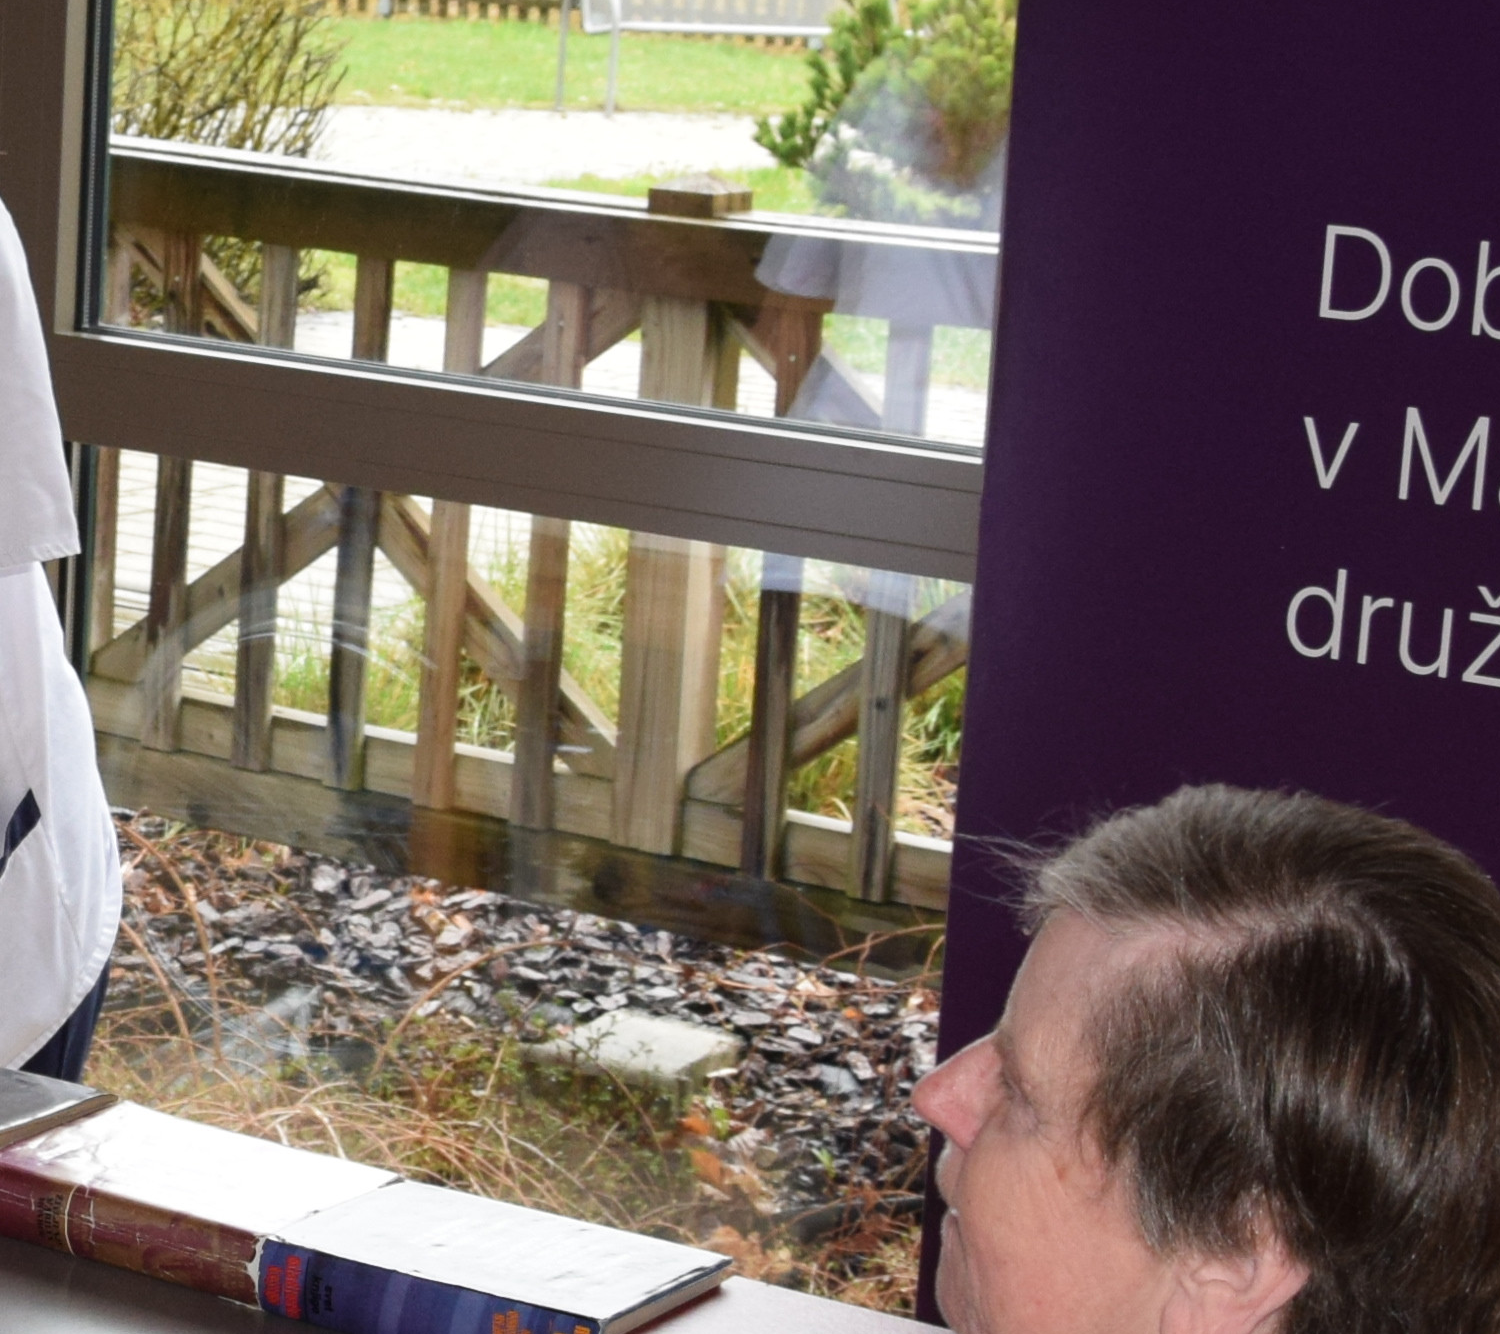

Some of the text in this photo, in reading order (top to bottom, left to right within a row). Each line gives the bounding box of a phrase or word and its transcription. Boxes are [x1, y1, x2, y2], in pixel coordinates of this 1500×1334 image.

[1301, 414, 1359, 492] v
[309, 1275, 323, 1314] knjige
[324, 1285, 334, 1313] svet
